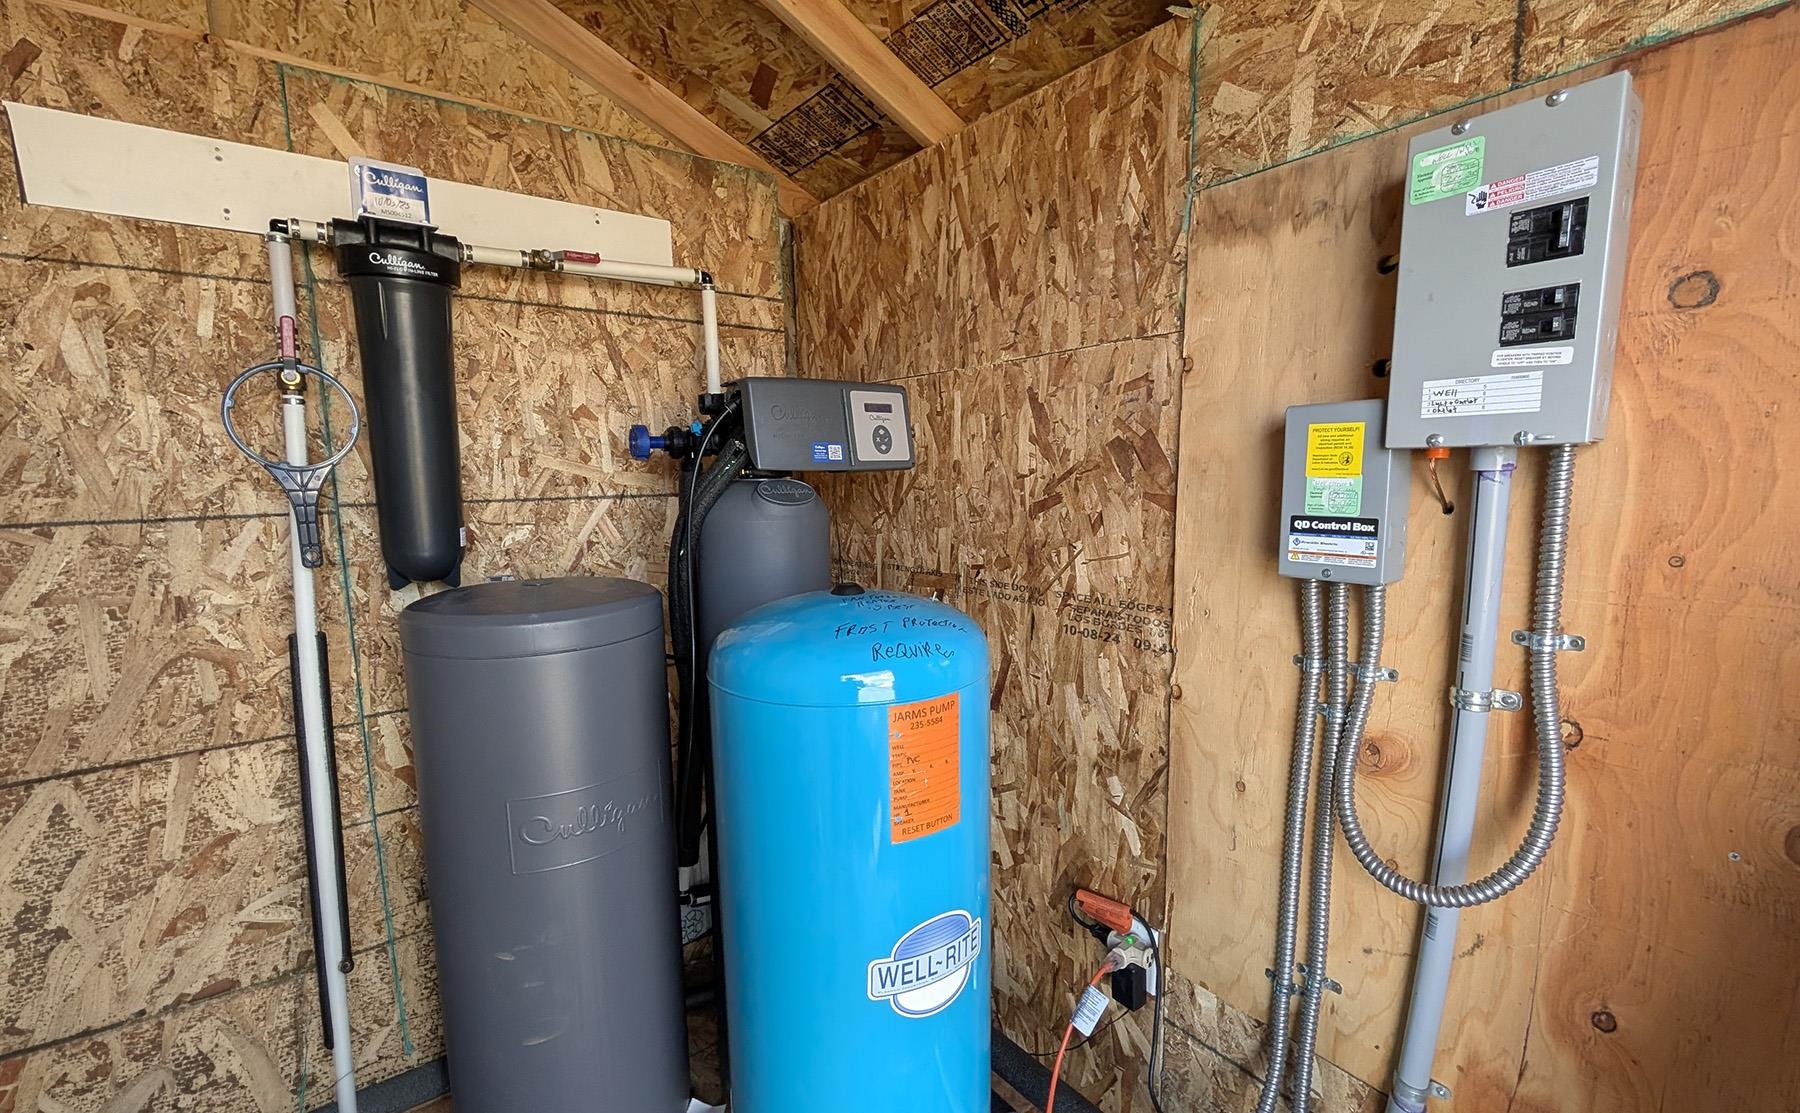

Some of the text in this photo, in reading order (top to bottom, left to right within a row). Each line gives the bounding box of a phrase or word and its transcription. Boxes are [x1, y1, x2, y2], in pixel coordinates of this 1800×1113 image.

[364, 171, 424, 194] Culligan
[1497, 176, 1524, 186] DANGER
[369, 252, 425, 272] Culligan
[761, 485, 813, 497] Culligan
[1294, 519, 1375, 532] QD Control Box
[990, 580, 1010, 590] SIDE
[1012, 582, 1040, 594] DOWN
[1056, 591, 1092, 604] SPACE
[1119, 600, 1163, 614] EDGES
[835, 620, 893, 639] FROST
[1125, 613, 1170, 628] TODOS
[1063, 624, 1121, 644] 10-08-24
[892, 700, 955, 723] JARMS PUMP
[910, 716, 943, 730] 235-5584
[520, 793, 660, 845] Culligan
[902, 813, 953, 836] RESET BUTTON
